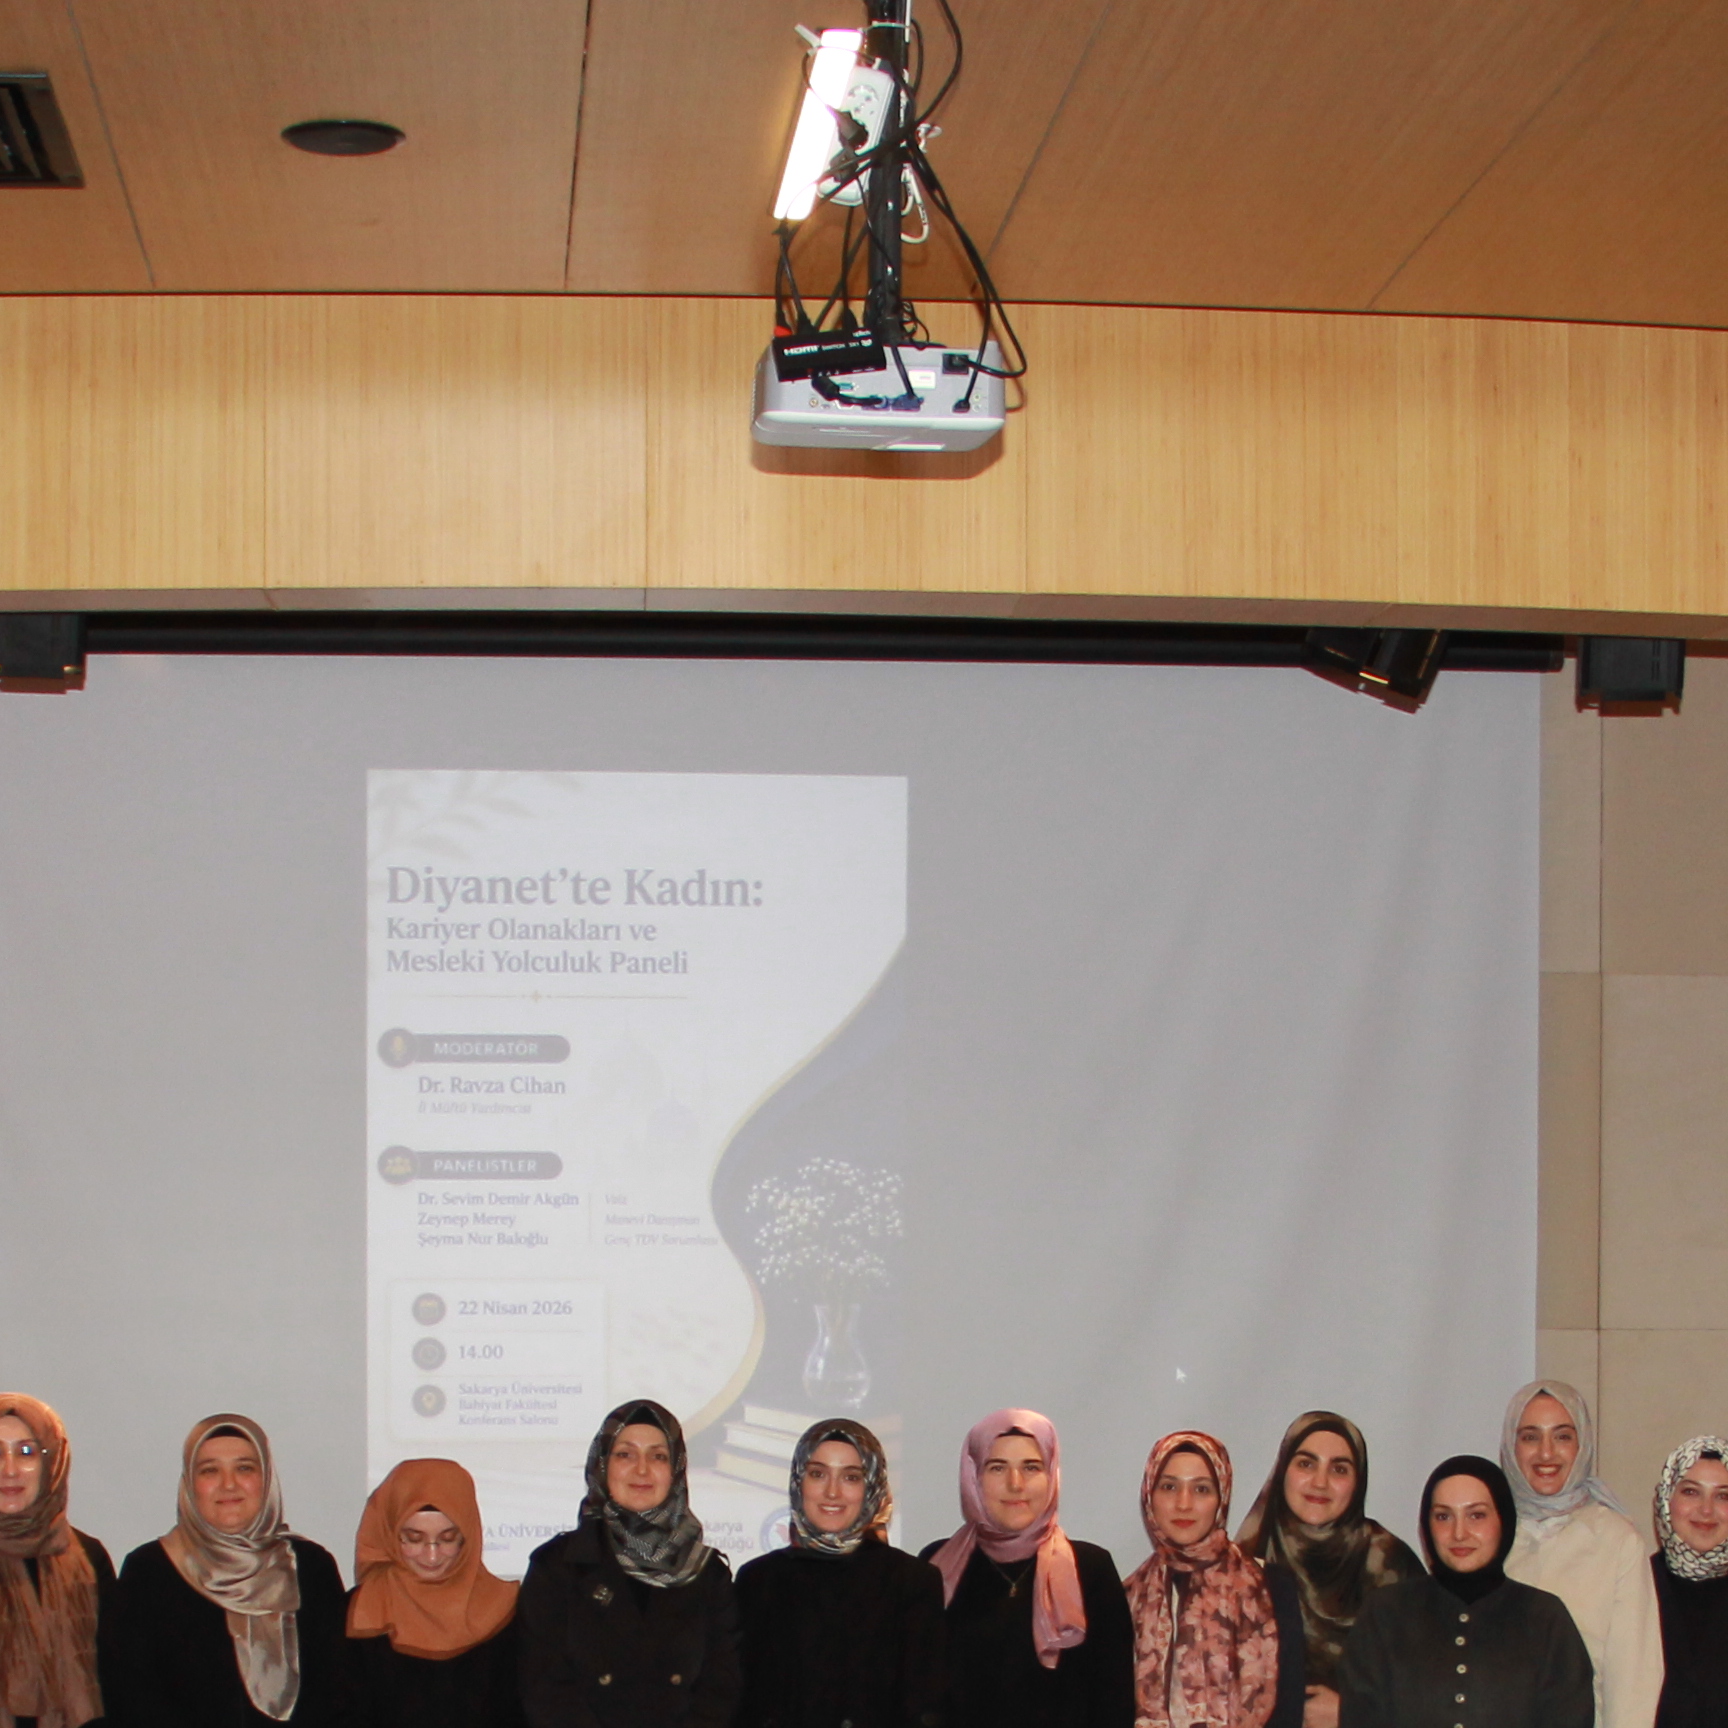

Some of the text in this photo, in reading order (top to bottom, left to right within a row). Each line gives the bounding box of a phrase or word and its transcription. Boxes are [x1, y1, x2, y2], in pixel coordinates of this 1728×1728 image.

[624, 868, 764, 907] Kadın:
[387, 917, 657, 945] Kariyer Olanakları ve
[387, 949, 689, 975] Mesleki Yolculuk Paneli
[433, 1040, 539, 1056] MODERATÖR
[418, 1076, 566, 1094] Dr. Ravza Cihan
[418, 1193, 579, 1208] Dr. Sevim Demir Akgün
[418, 1213, 516, 1228] Zeynep Merey
[417, 1232, 549, 1248] Şeyma Nur Baloğlu
[458, 1300, 573, 1315] 22 Nisan 2026
[459, 1344, 504, 1359] 14.00
[458, 1381, 583, 1396] Sakarya Üniversitesi
